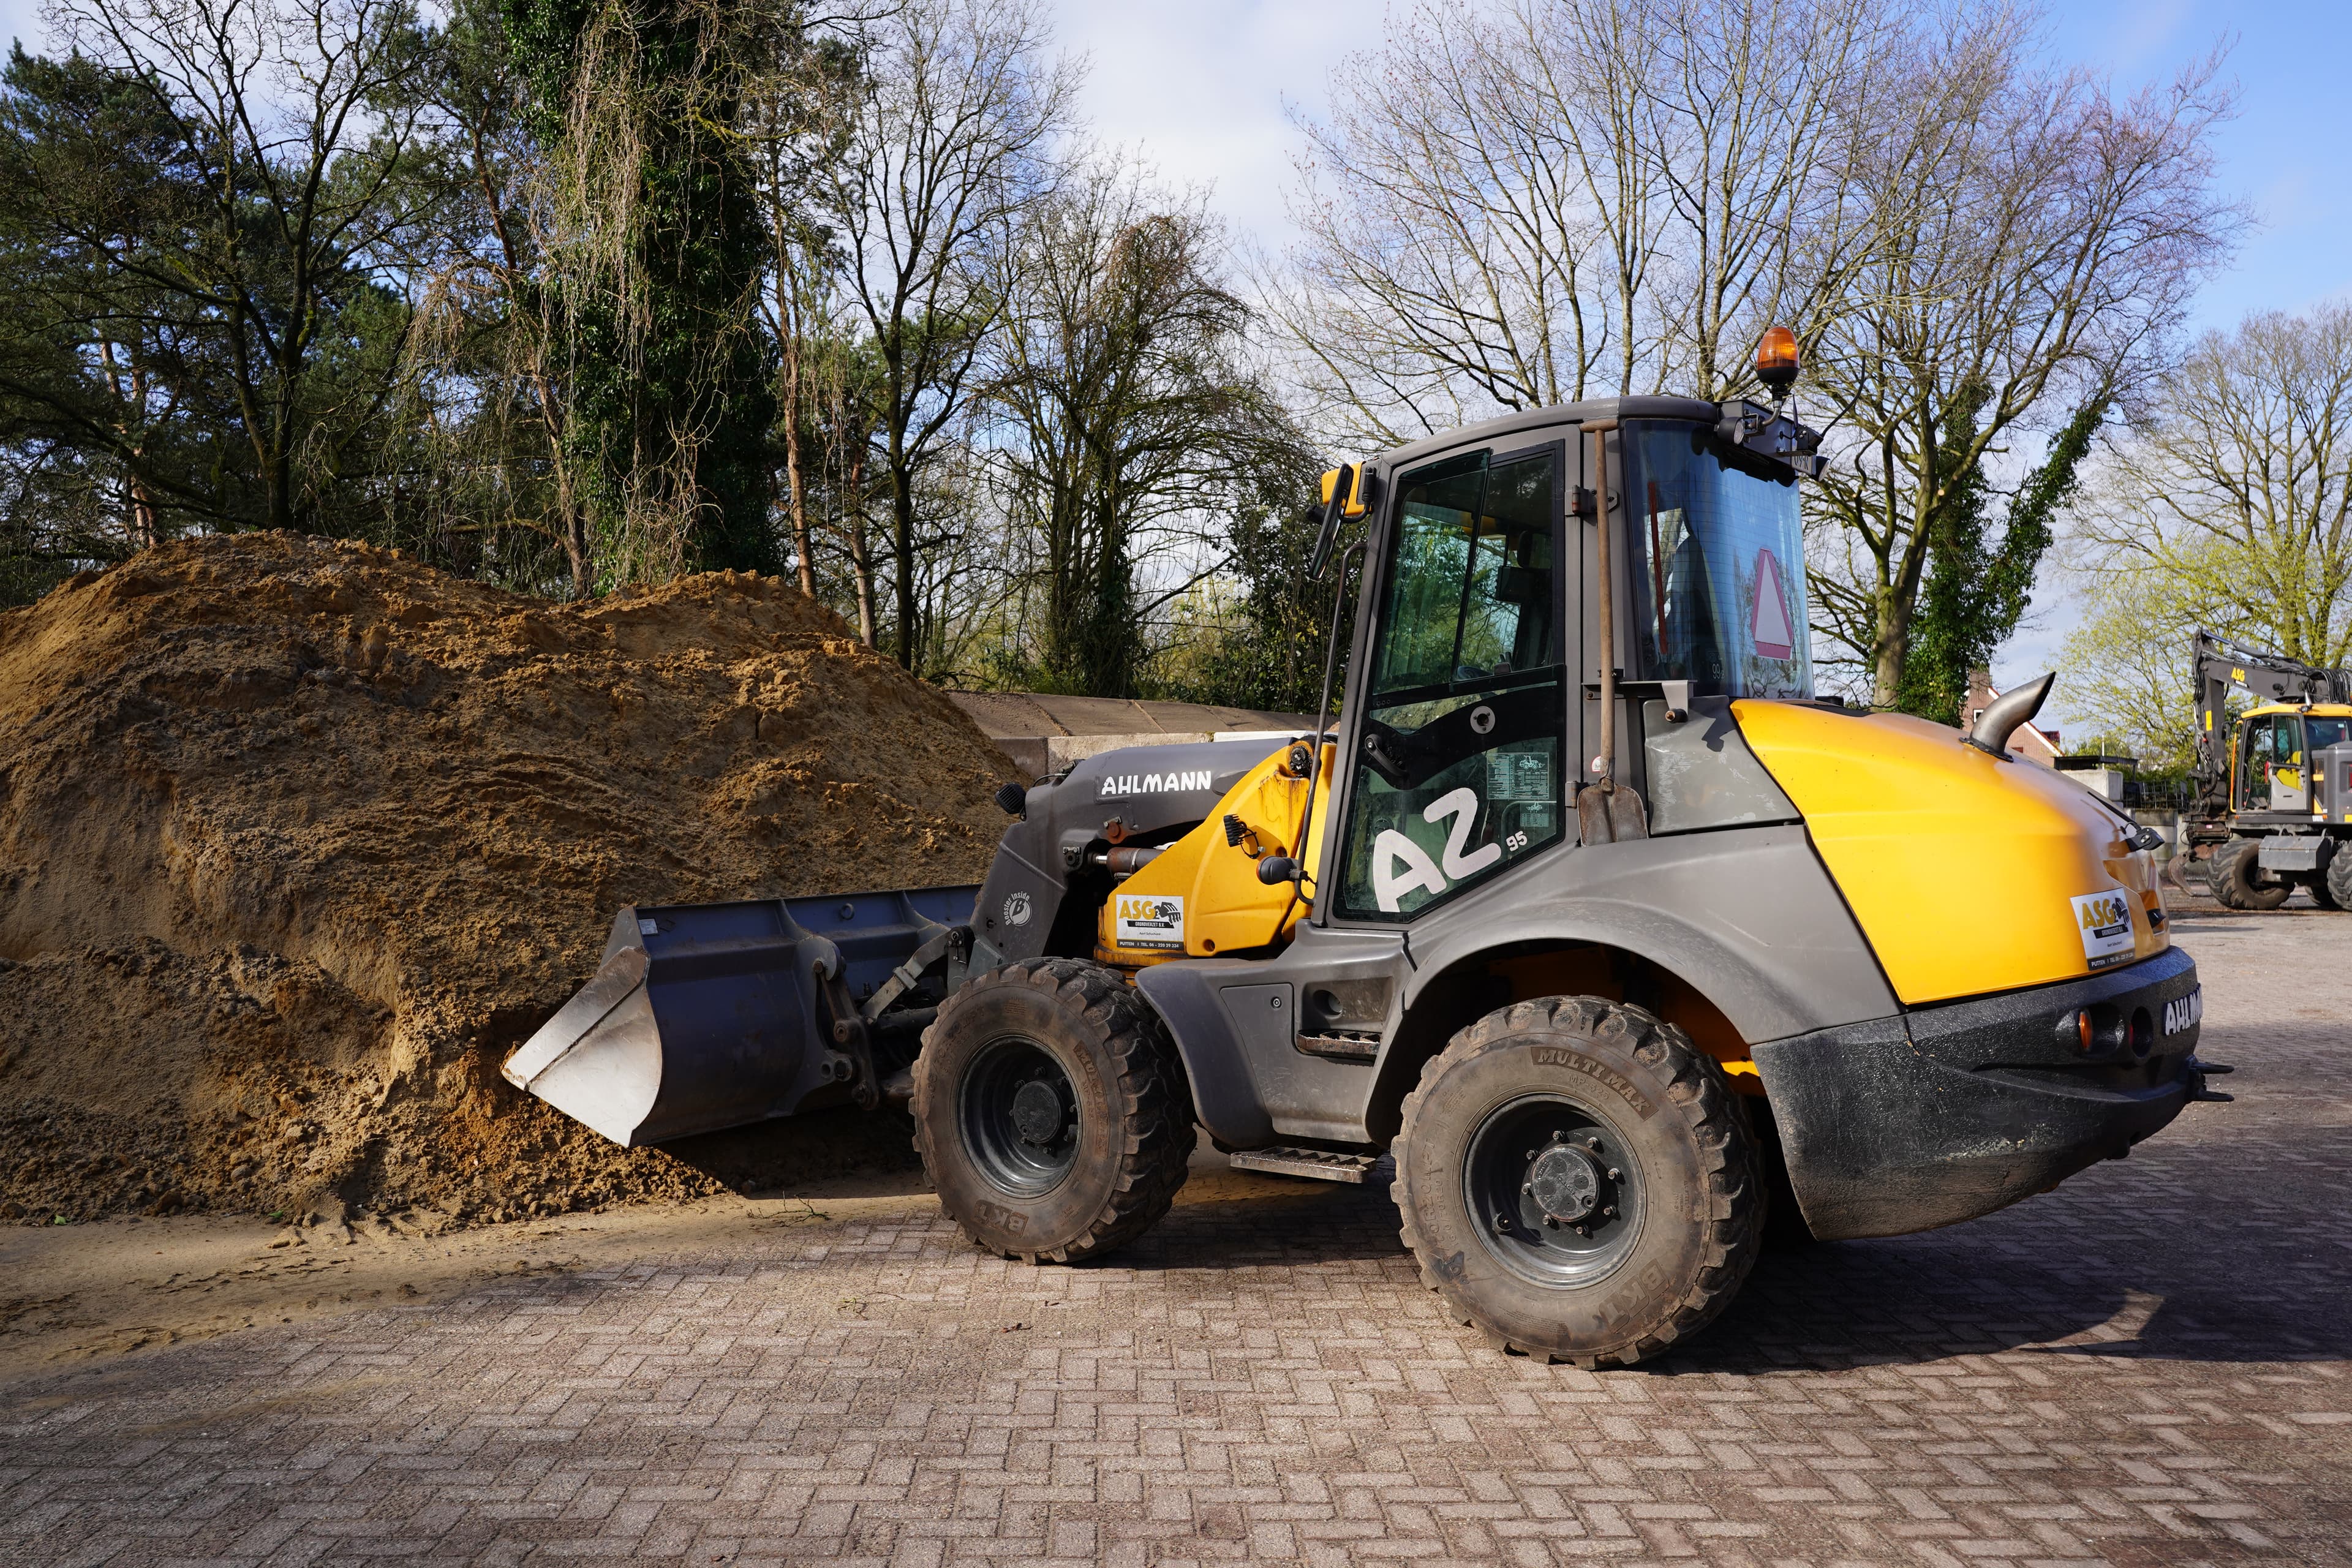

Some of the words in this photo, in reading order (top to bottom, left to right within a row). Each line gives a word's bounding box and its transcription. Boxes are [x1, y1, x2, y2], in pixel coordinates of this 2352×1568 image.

[2231, 667, 2245, 682] ASG
[1102, 771, 1212, 795] AHLMANN
[1373, 788, 1502, 913] AZ
[1506, 831, 1528, 852] 95
[1011, 891, 1030, 901] Inside
[1119, 900, 1156, 920] ASG
[2082, 899, 2115, 929] ASG
[1538, 1049, 1605, 1078] MULTI
[1605, 1072, 1650, 1112] MAX
[977, 1202, 1027, 1235] BKT
[1603, 1262, 1668, 1329] BKT
